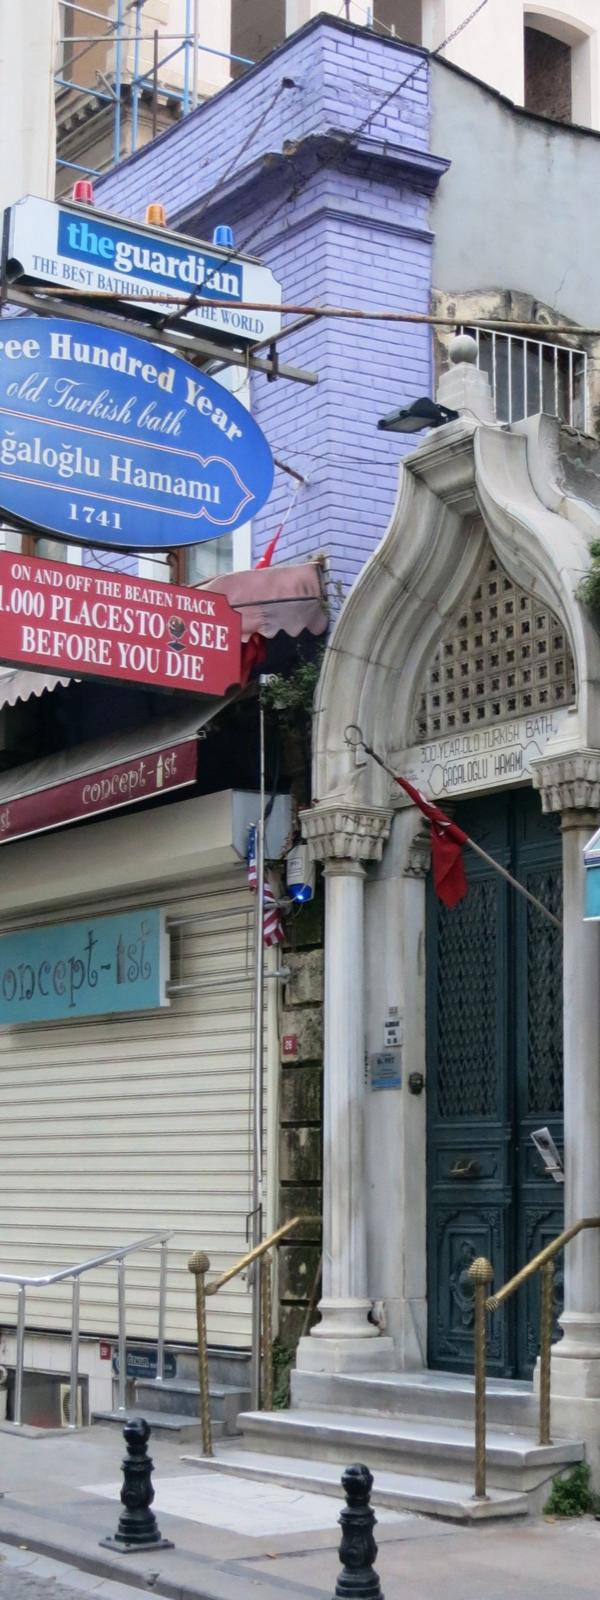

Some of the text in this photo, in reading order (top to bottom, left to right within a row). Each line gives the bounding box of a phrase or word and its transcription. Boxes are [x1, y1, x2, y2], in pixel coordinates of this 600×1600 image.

[32, 255, 58, 275] THE
[62, 263, 95, 285] BEST
[221, 310, 265, 335] WORLD
[6, 372, 188, 437] old Turkish bath
[49, 331, 176, 394] Hundred
[184, 376, 243, 442] Year
[110, 454, 222, 504] Hamamı
[68, 503, 123, 530] 1741
[11, 562, 216, 617] ON AND OFF THE BEATEN TRACK
[21, 625, 204, 682] BEFORE YOU DIE
[189, 619, 229, 652] SEE
